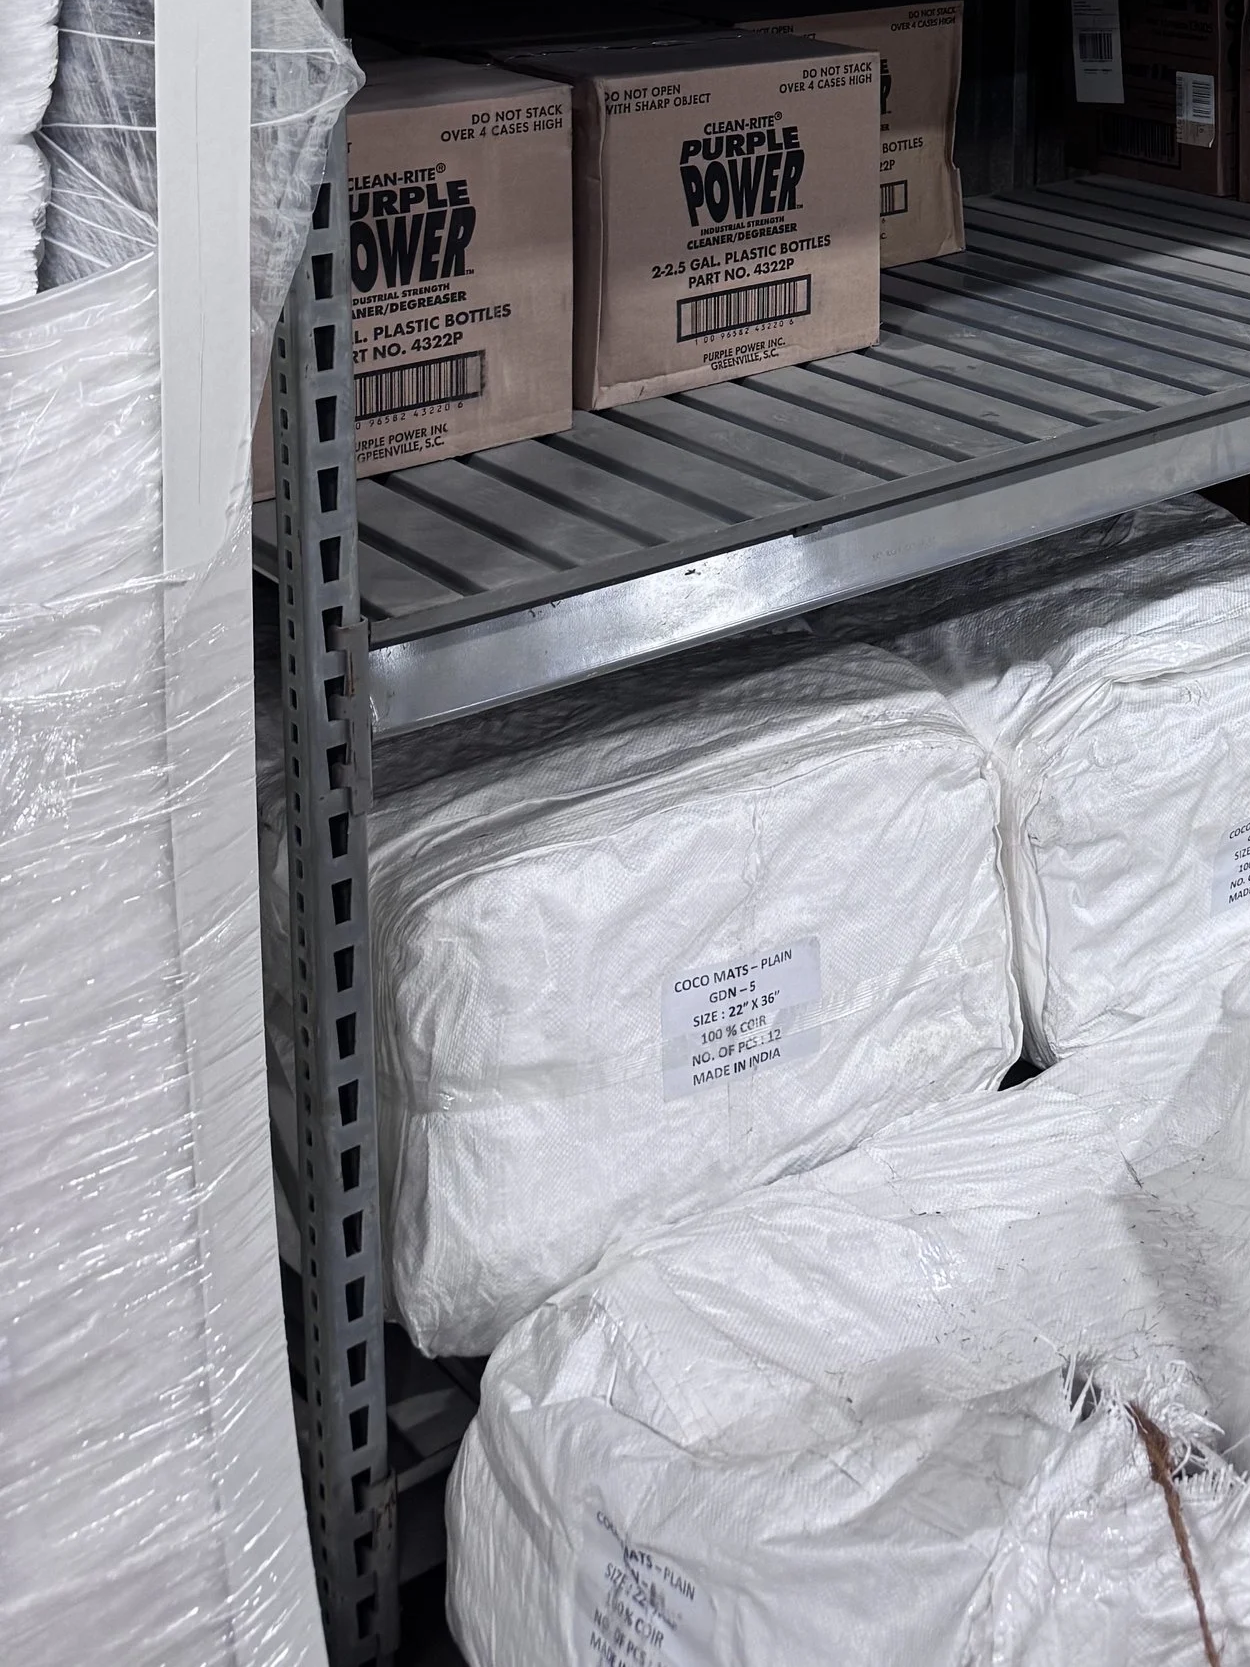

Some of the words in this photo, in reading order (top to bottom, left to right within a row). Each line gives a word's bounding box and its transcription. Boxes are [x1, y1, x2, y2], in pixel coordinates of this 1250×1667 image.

[441, 128, 475, 142] OVER
[479, 126, 487, 139] 4
[491, 121, 530, 137] CASES
[533, 117, 563, 132] HIGH
[471, 112, 490, 125] DO
[496, 108, 522, 123] NOT
[526, 104, 563, 120] STACK
[680, 126, 801, 166] PURPLE
[680, 149, 805, 227] POWER
[687, 222, 798, 251] CLEANER/DEGREASER
[700, 222, 746, 236] INDUSTRIAL
[746, 216, 785, 229] STRENGTH
[652, 261, 687, 279] 2-2.5
[690, 254, 721, 272] GAL.
[725, 244, 777, 265] PLASTIC
[780, 234, 831, 254] BOTTLES
[689, 270, 721, 289] PART
[724, 266, 750, 282] NO.
[753, 258, 795, 276] 4322P
[674, 974, 710, 993] COCO
[713, 964, 749, 984] MATS
[761, 949, 793, 970] PLAIN
[709, 986, 737, 1003] GDN
[750, 980, 756, 992] 5
[693, 1011, 718, 1028] SIZE
[751, 999, 759, 1011] X
[701, 1029, 722, 1045] 100
[726, 1026, 737, 1038] %
[740, 1015, 766, 1034] COIR
[692, 1051, 715, 1067] NO.
[718, 1045, 735, 1059] OF
[738, 1037, 757, 1053] PCS
[767, 1028, 782, 1042] 12
[693, 1065, 730, 1086] MADE
[734, 1060, 746, 1074] IN
[749, 1047, 781, 1068] INDIA
